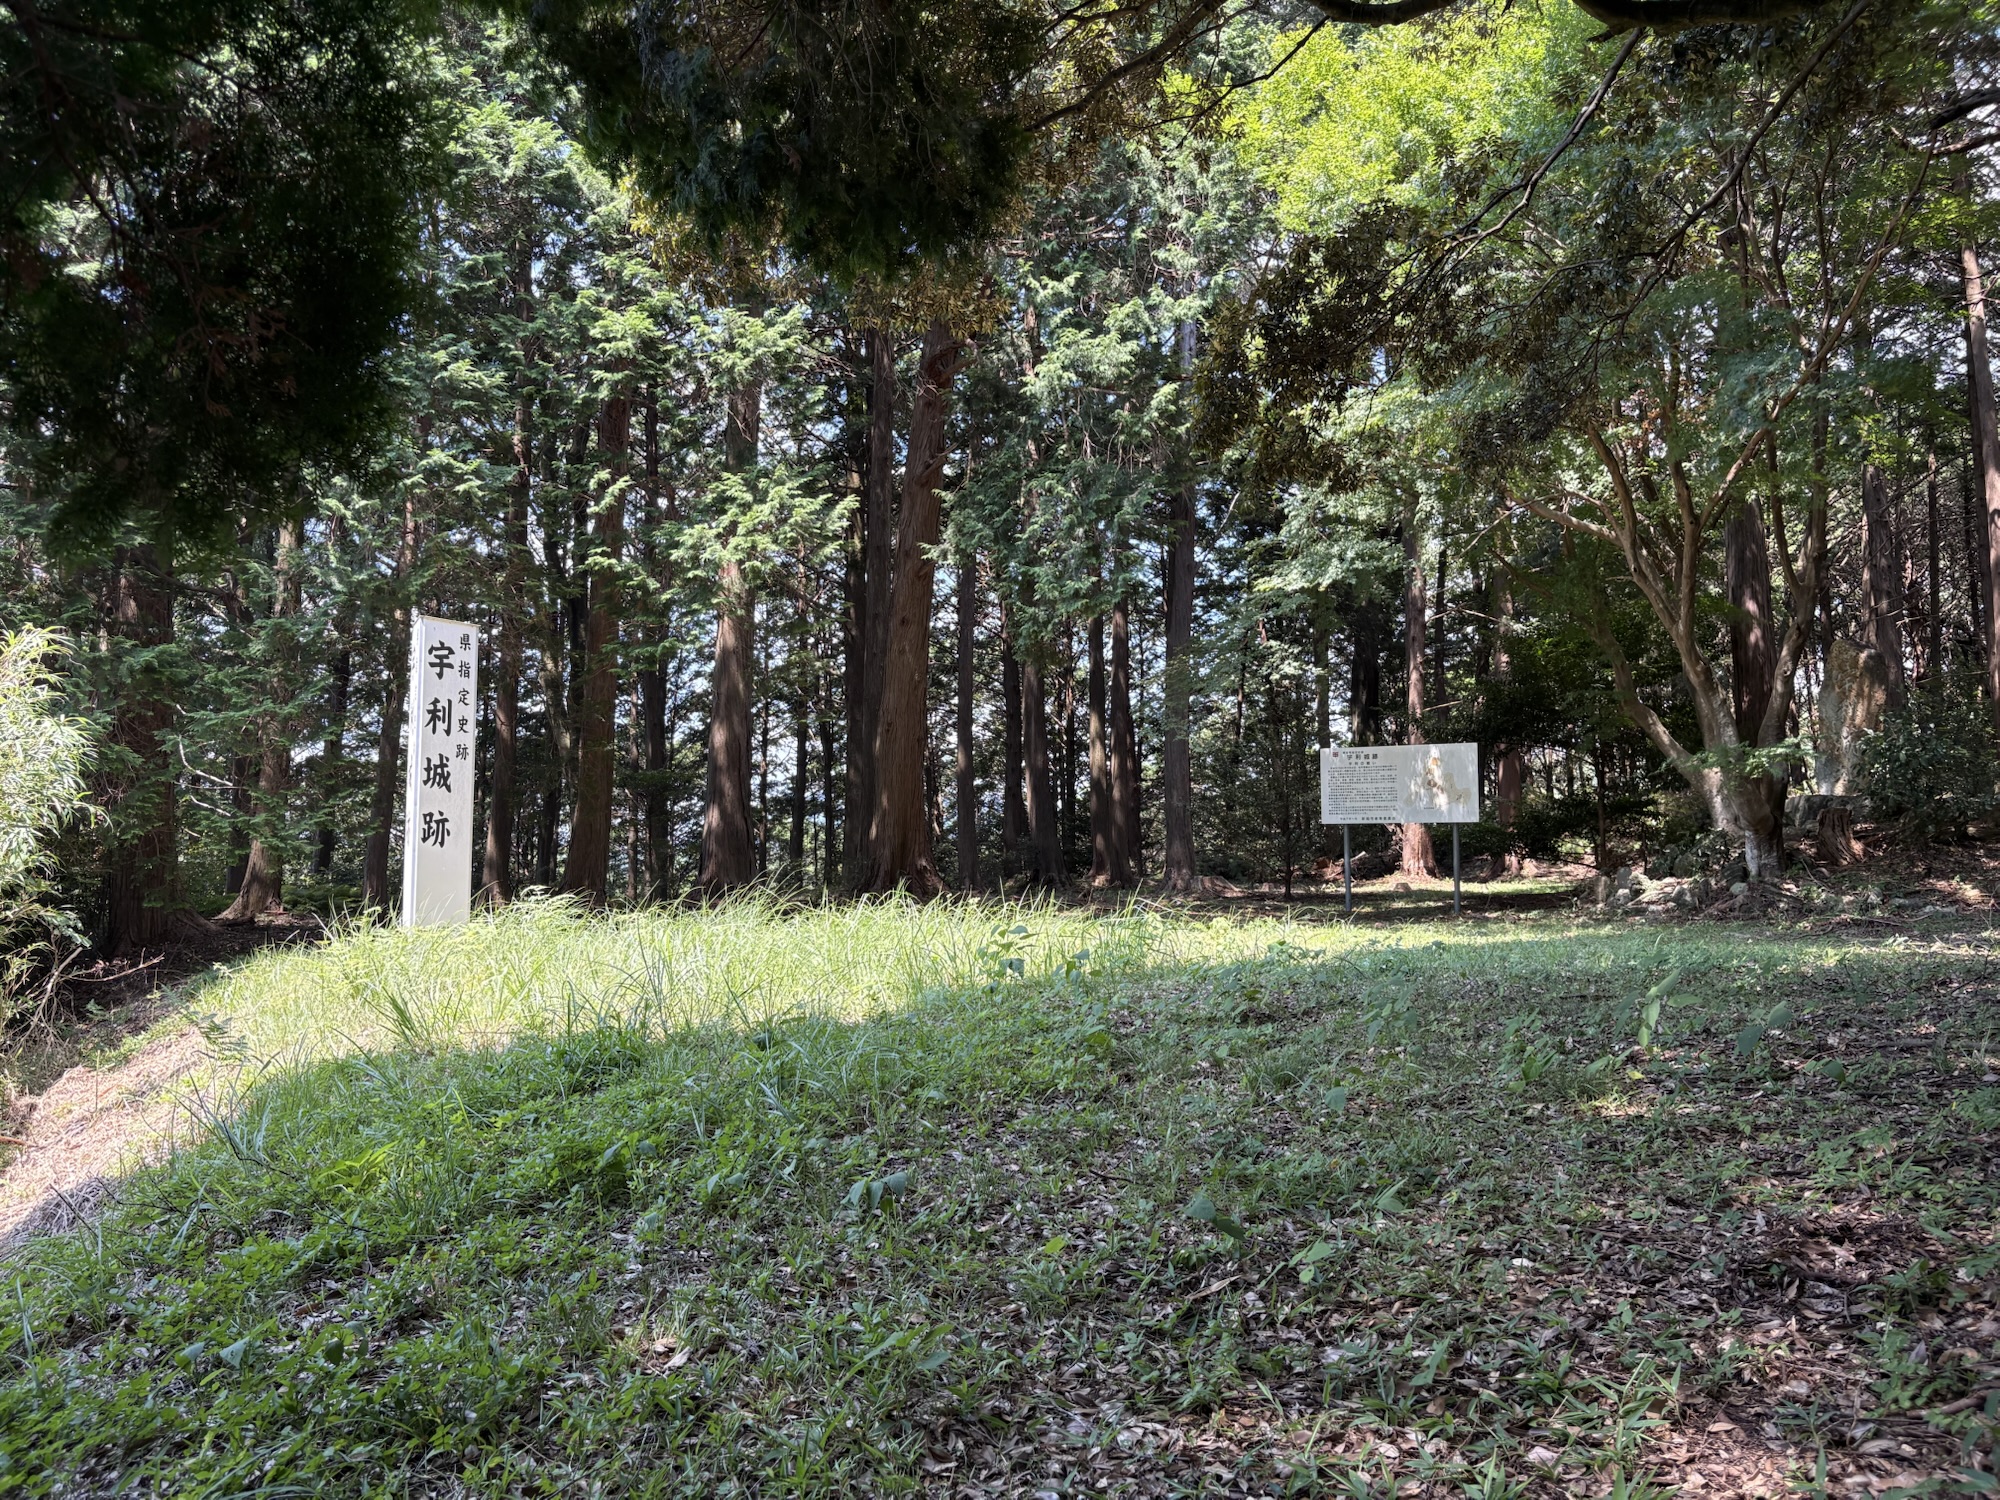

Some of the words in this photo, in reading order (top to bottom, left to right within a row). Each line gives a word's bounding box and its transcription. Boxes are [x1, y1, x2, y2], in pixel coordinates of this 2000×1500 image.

[421, 640, 455, 848] 宇利城跡
[455, 633, 471, 761] 県指定史跡
